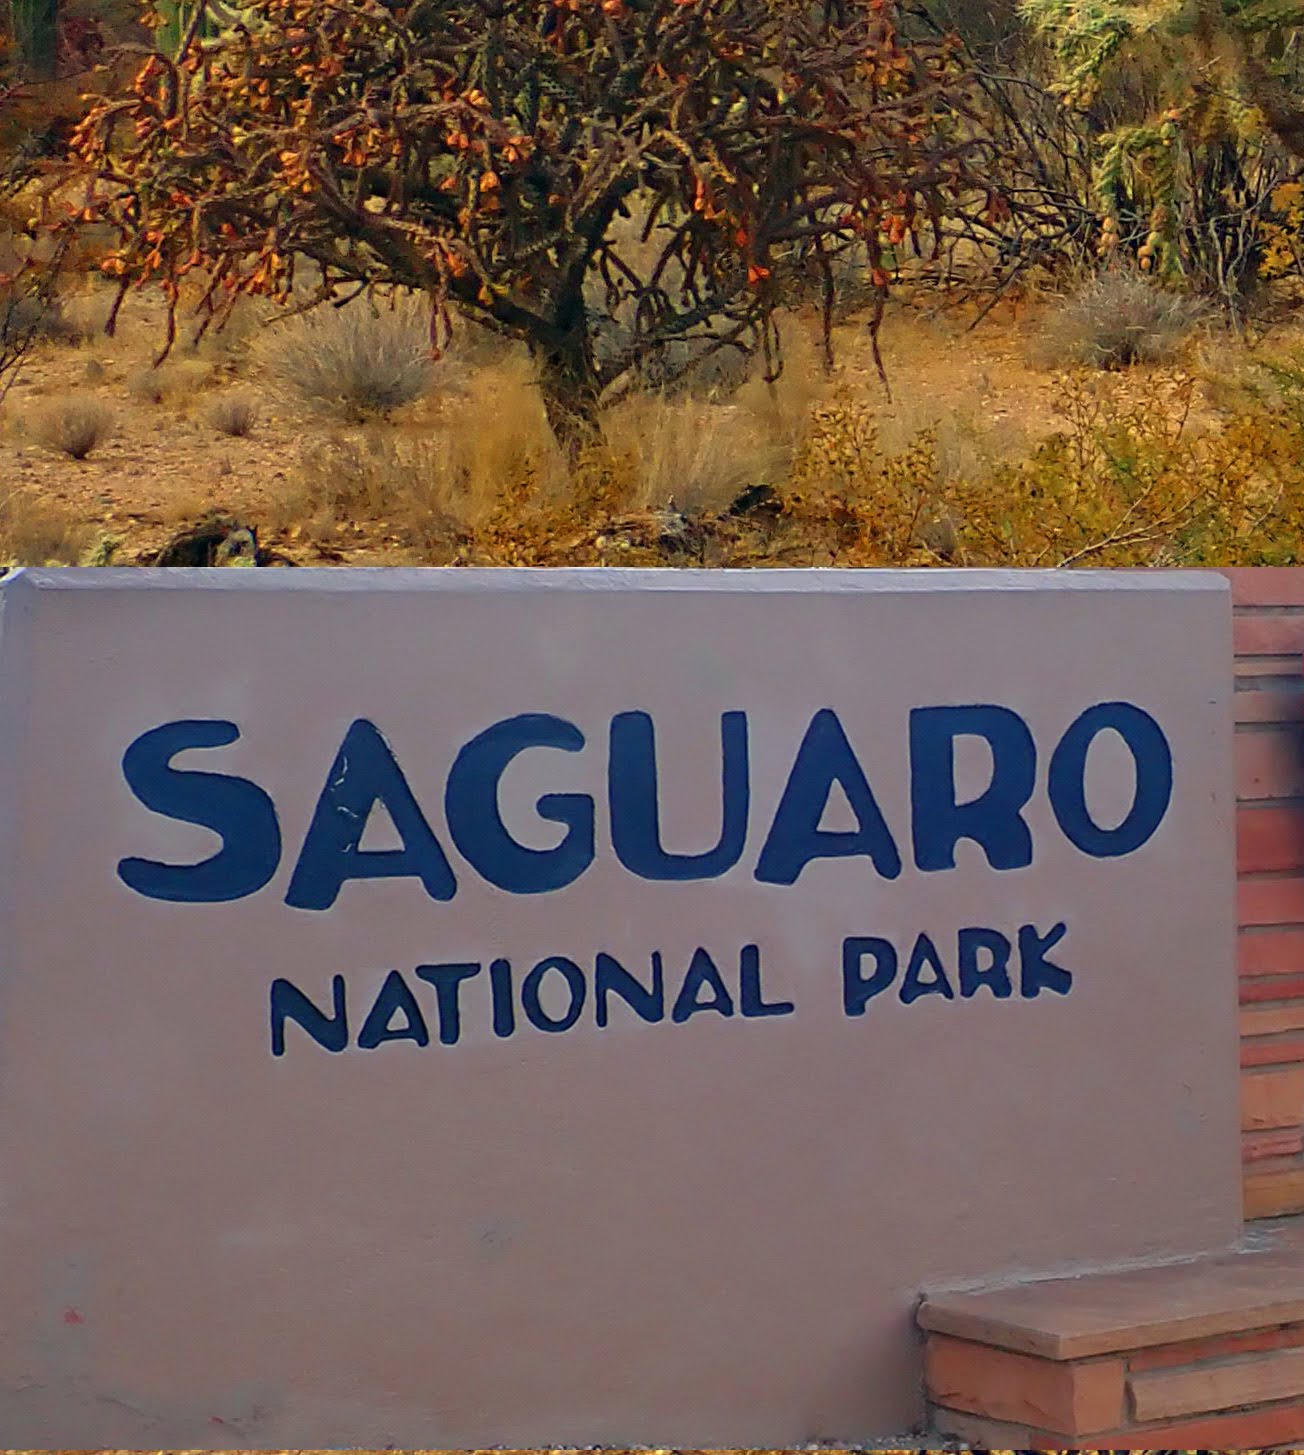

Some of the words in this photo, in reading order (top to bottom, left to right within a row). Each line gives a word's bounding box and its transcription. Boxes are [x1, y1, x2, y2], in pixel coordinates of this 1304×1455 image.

[116, 701, 1174, 911] SAGUARO
[270, 943, 795, 1057] NATIONAL
[843, 921, 1073, 1017] PARK
